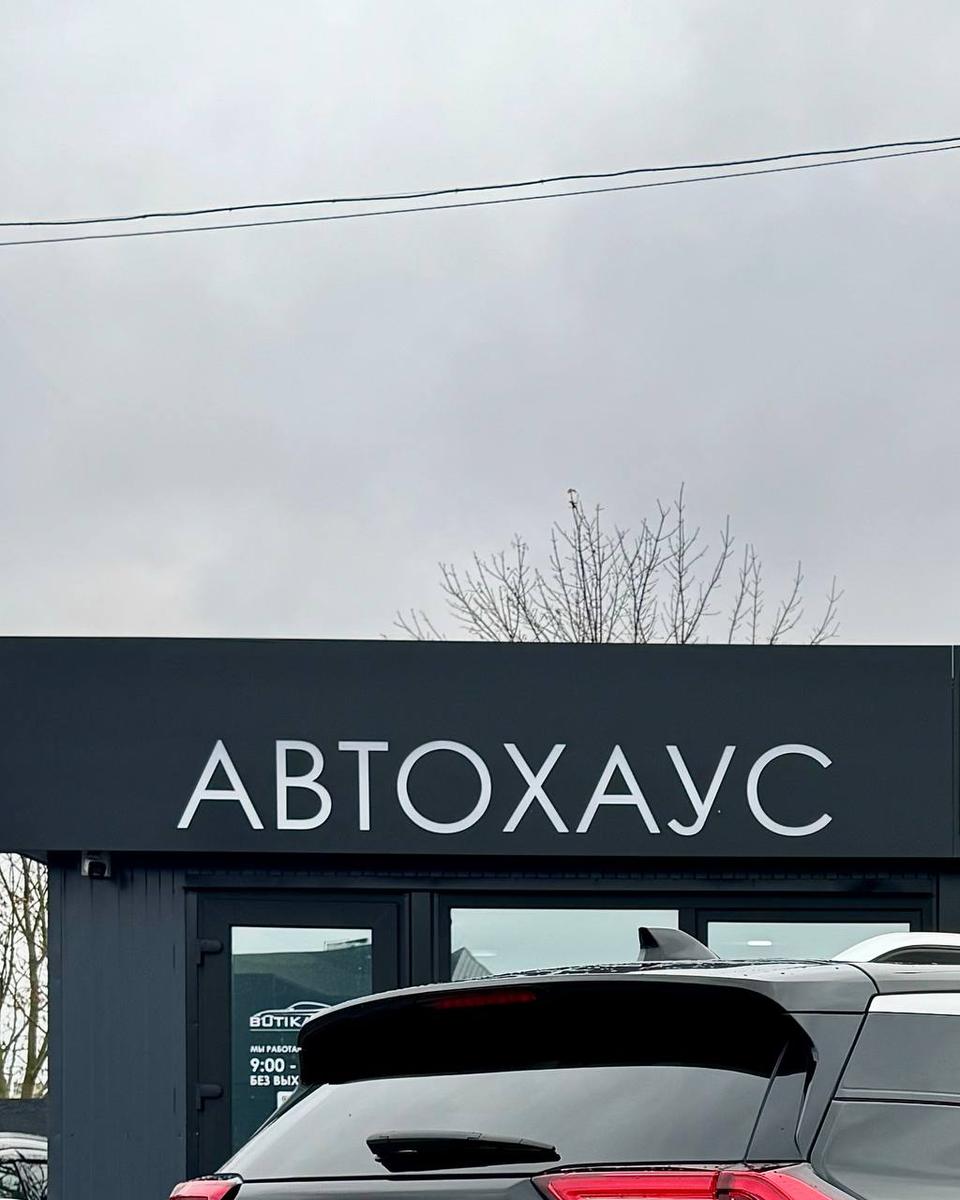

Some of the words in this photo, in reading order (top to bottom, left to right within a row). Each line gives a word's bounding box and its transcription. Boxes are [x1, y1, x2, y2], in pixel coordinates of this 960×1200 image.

[176, 739, 833, 838] АВТОХАУС
[250, 1045, 265, 1053] МЫ
[250, 1058, 285, 1072] 9:00
[250, 1075, 271, 1086] БЕЗ
